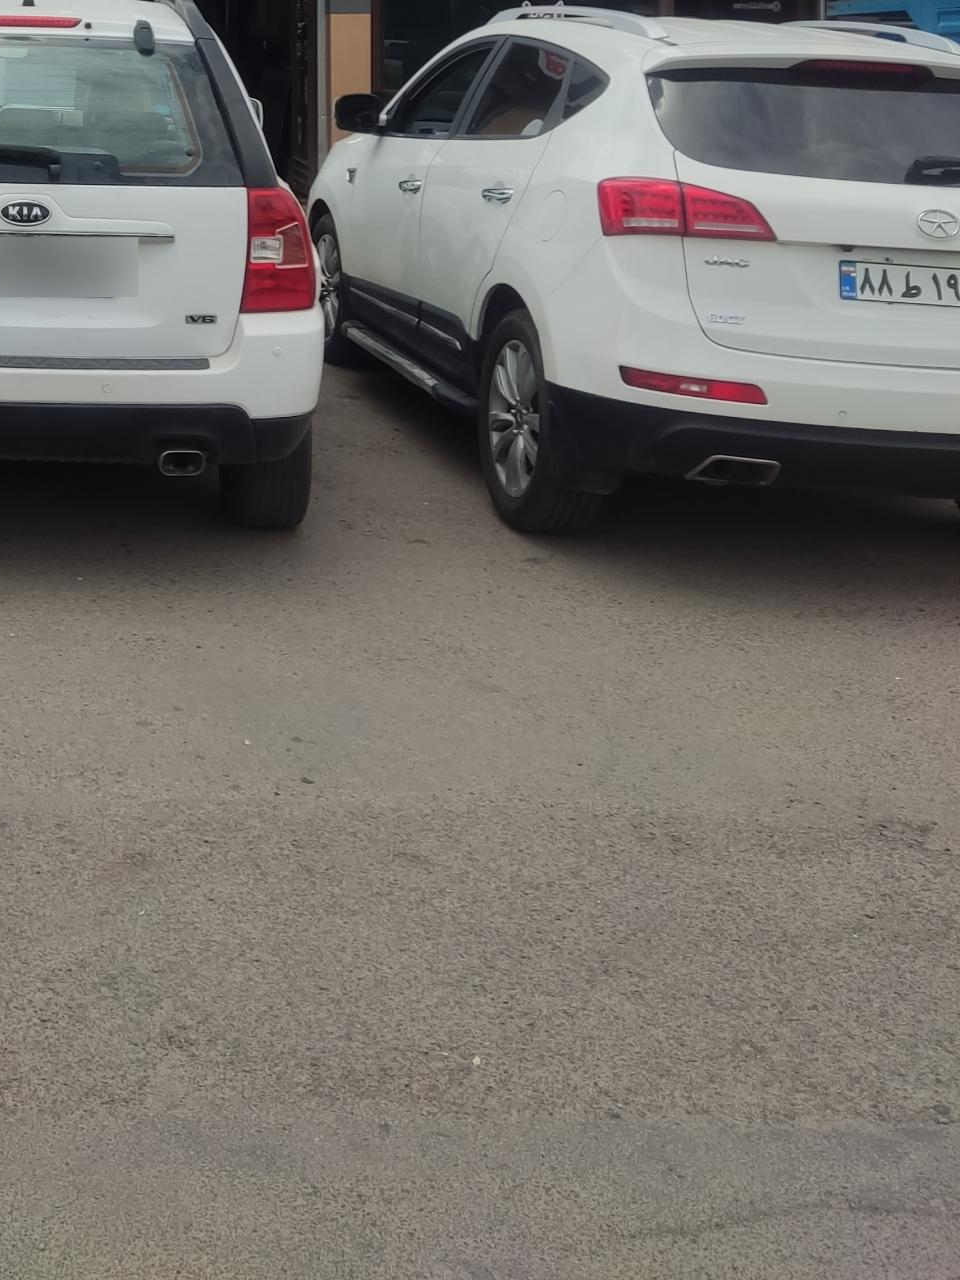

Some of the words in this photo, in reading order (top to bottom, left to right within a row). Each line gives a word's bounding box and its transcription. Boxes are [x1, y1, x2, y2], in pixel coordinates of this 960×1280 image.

[7, 204, 43, 220] KIA
[860, 267, 893, 297] ۸۸
[187, 315, 216, 324] V6
